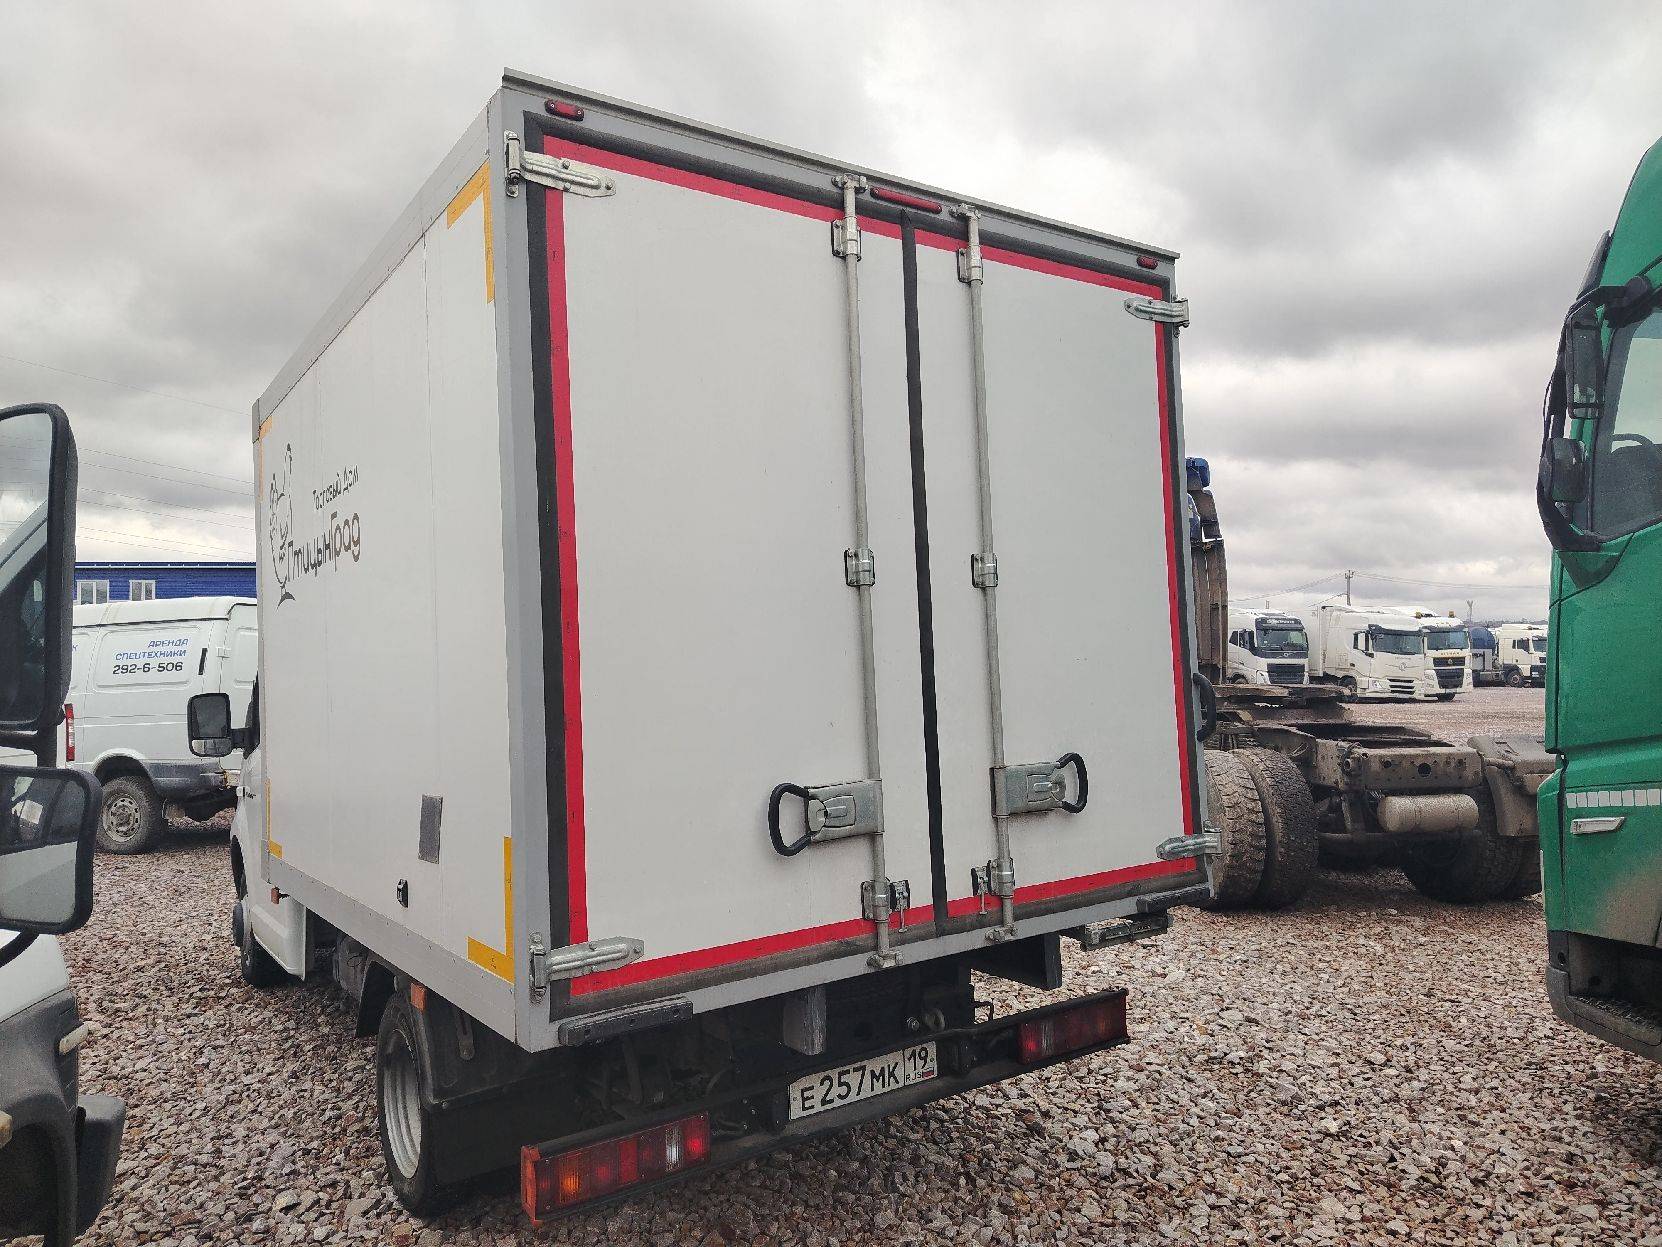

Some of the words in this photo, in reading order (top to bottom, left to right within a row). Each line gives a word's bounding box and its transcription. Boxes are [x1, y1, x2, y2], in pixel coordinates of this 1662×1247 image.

[148, 638, 189, 648] АРЕНДА
[115, 649, 187, 661] СПЕЦТЕХНИКИ
[112, 661, 184, 675] 292-6-506
[907, 1046, 929, 1072] 19
